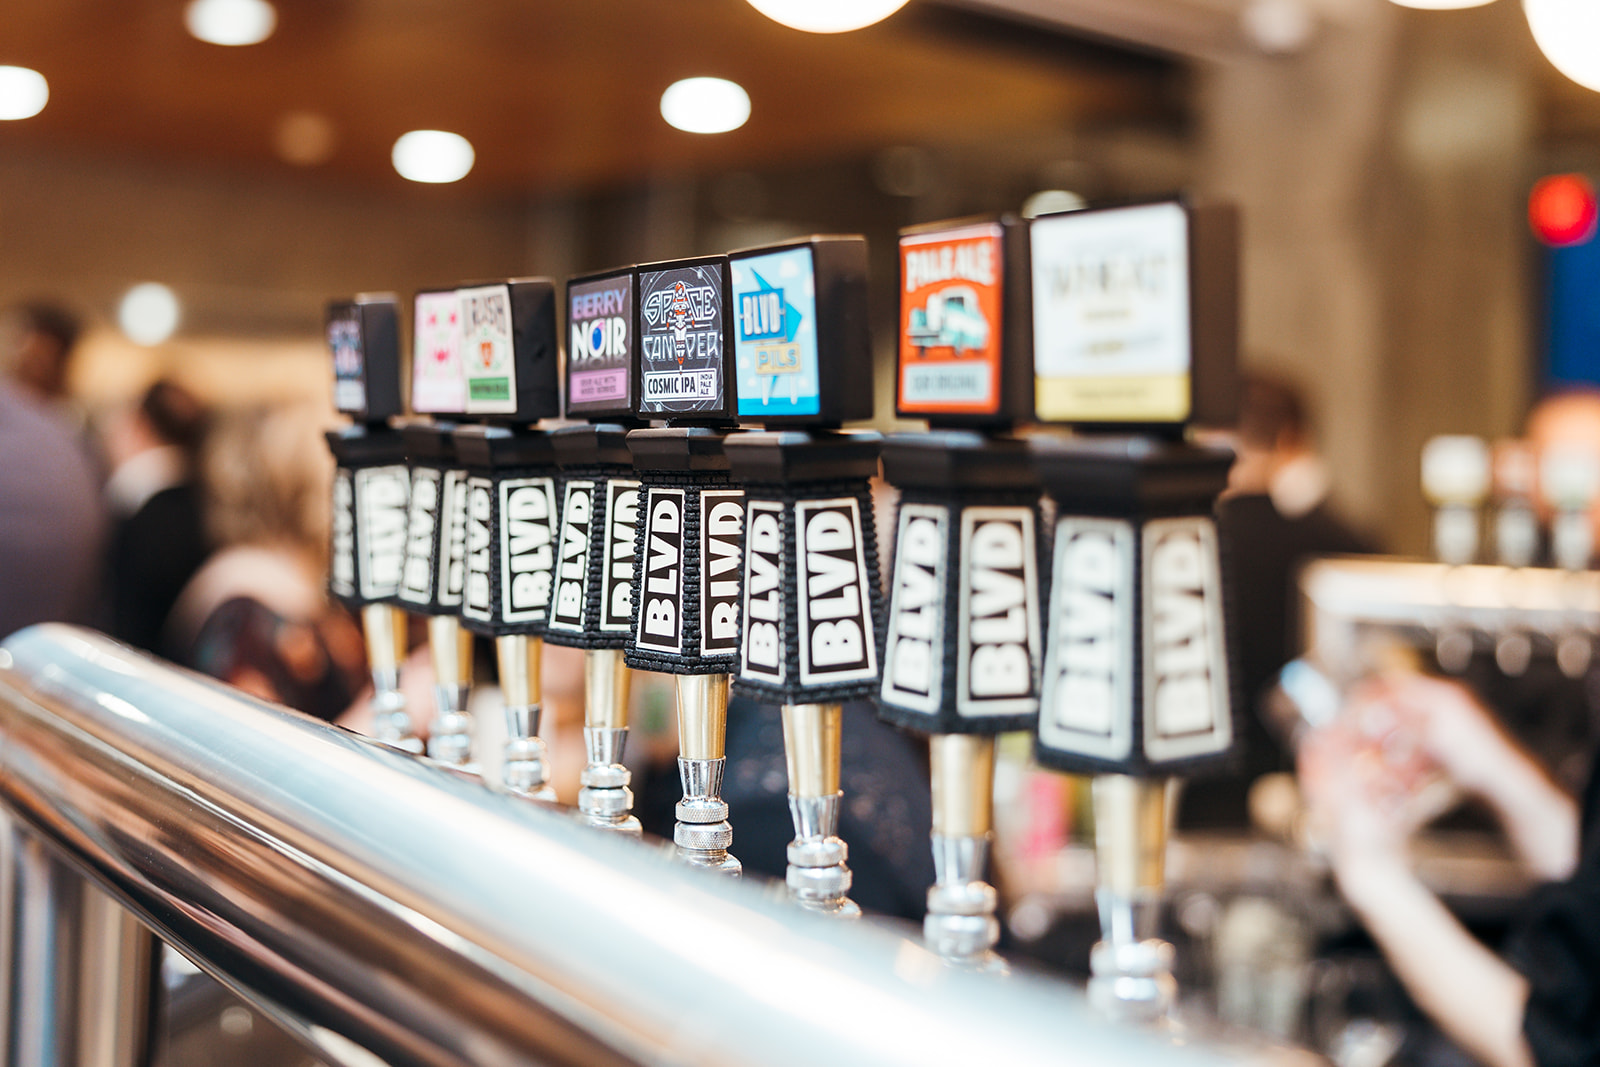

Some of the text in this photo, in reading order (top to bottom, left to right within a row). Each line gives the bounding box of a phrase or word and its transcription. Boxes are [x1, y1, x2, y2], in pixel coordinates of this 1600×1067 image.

[572, 288, 627, 320] BERRY
[906, 241, 994, 293] PALE ALE
[571, 317, 627, 361] NOIR
[743, 292, 780, 335] BLVD
[648, 375, 696, 394] COSMIC IPA
[758, 349, 797, 368] PILS
[508, 487, 553, 608] BLVD
[557, 491, 592, 617] BLVD
[645, 500, 680, 637] BLVD
[748, 513, 780, 668] BLVD
[806, 511, 864, 667] BLVD
[969, 521, 1031, 697] BLVD
